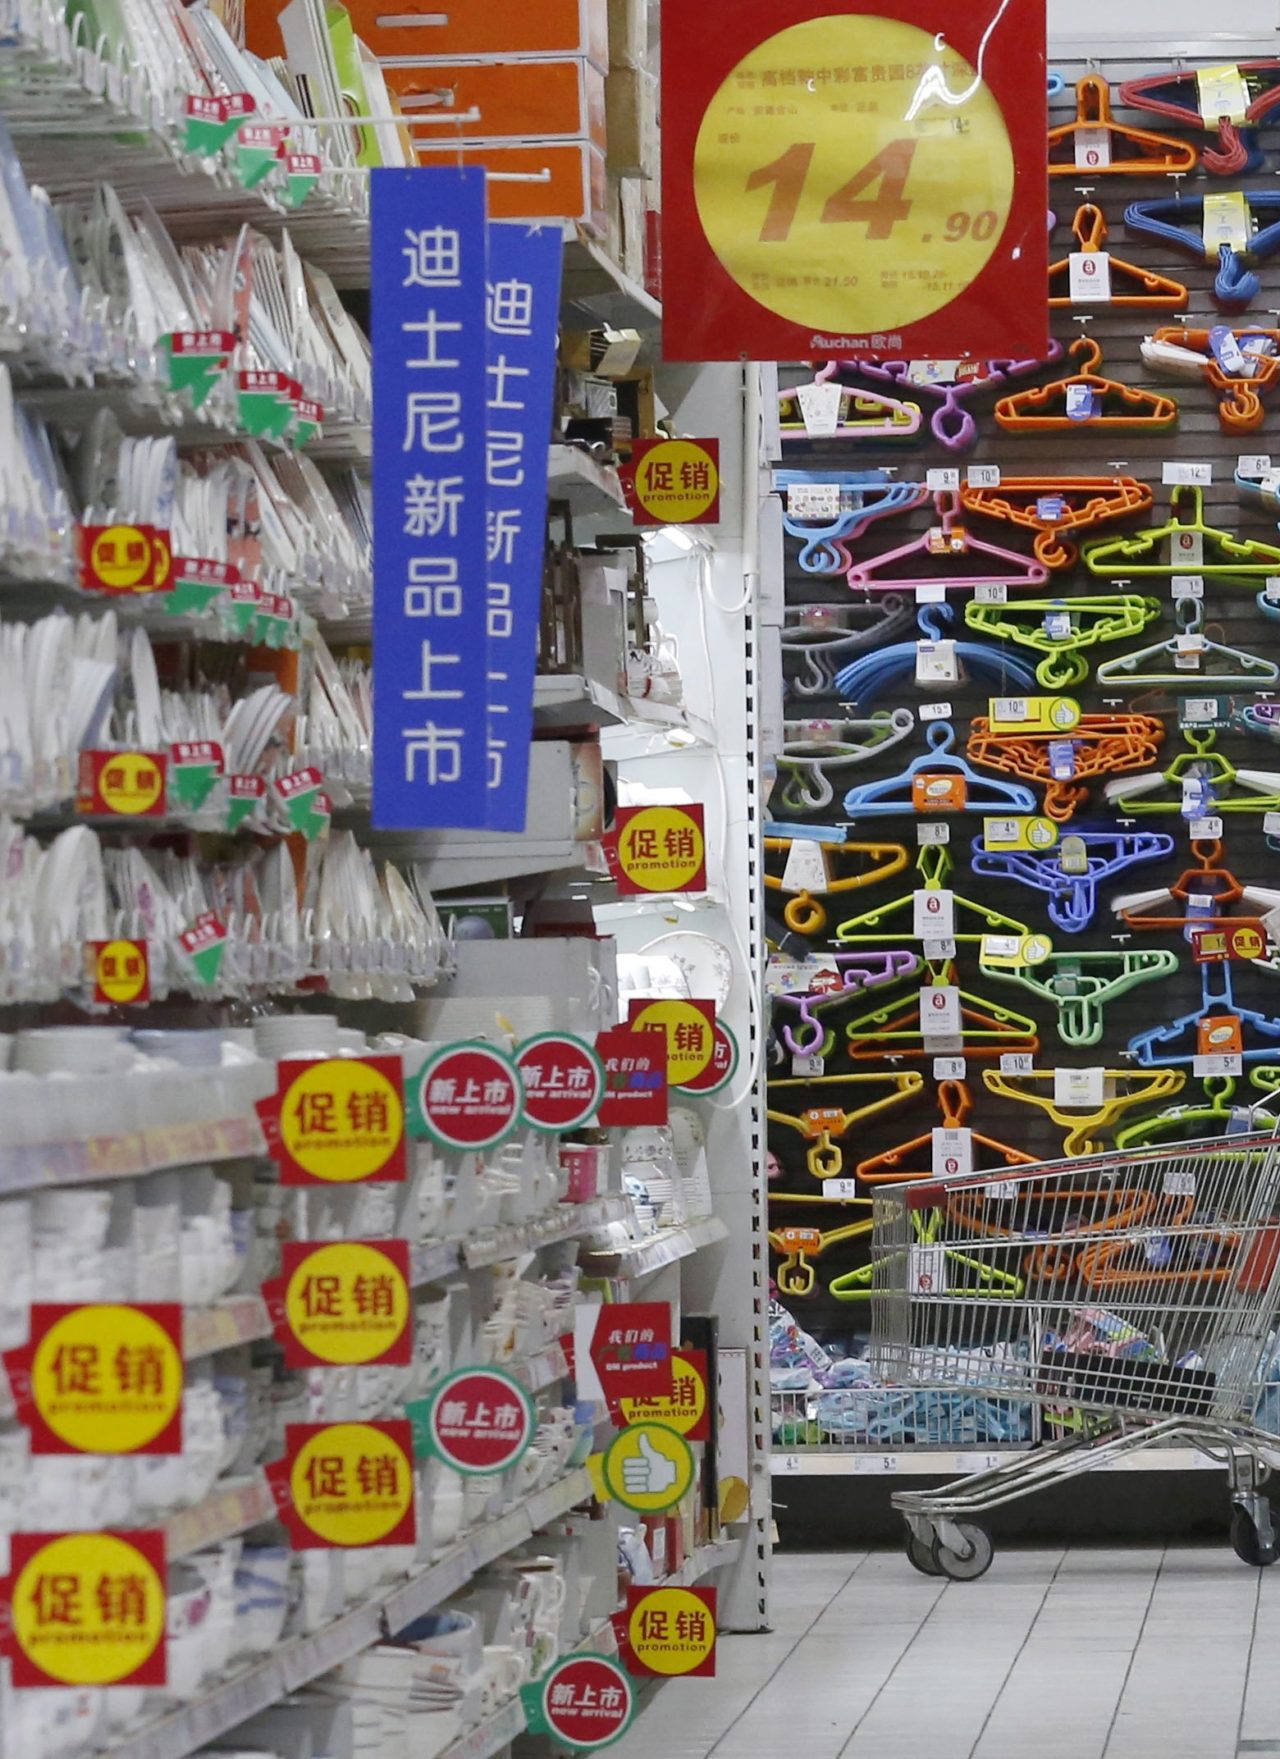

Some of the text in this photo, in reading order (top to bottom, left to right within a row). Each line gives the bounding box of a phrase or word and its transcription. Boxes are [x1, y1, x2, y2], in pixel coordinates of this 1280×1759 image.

[810, 334, 903, 349] Auchan 欧尚
[644, 461, 710, 491] 促销
[402, 226, 464, 786] 迪士尼新品上市
[643, 492, 710, 503] promotion
[627, 827, 695, 860] 促销
[627, 859, 696, 872] promotion
[429, 1077, 510, 1105] 新上市
[521, 1064, 591, 1090] 新上市
[293, 1090, 389, 1135] 促销
[300, 1274, 395, 1318] 促销
[49, 1343, 166, 1397] 促销
[439, 1403, 519, 1429] 新上市
[628, 1407, 698, 1420] promotion
[304, 1455, 399, 1499] 促销
[31, 1573, 148, 1627] 促销
[638, 1610, 706, 1642] 促销
[636, 1641, 706, 1653] promotion
[550, 1681, 622, 1708] 新上市
[581, 1706, 624, 1720] arrival
